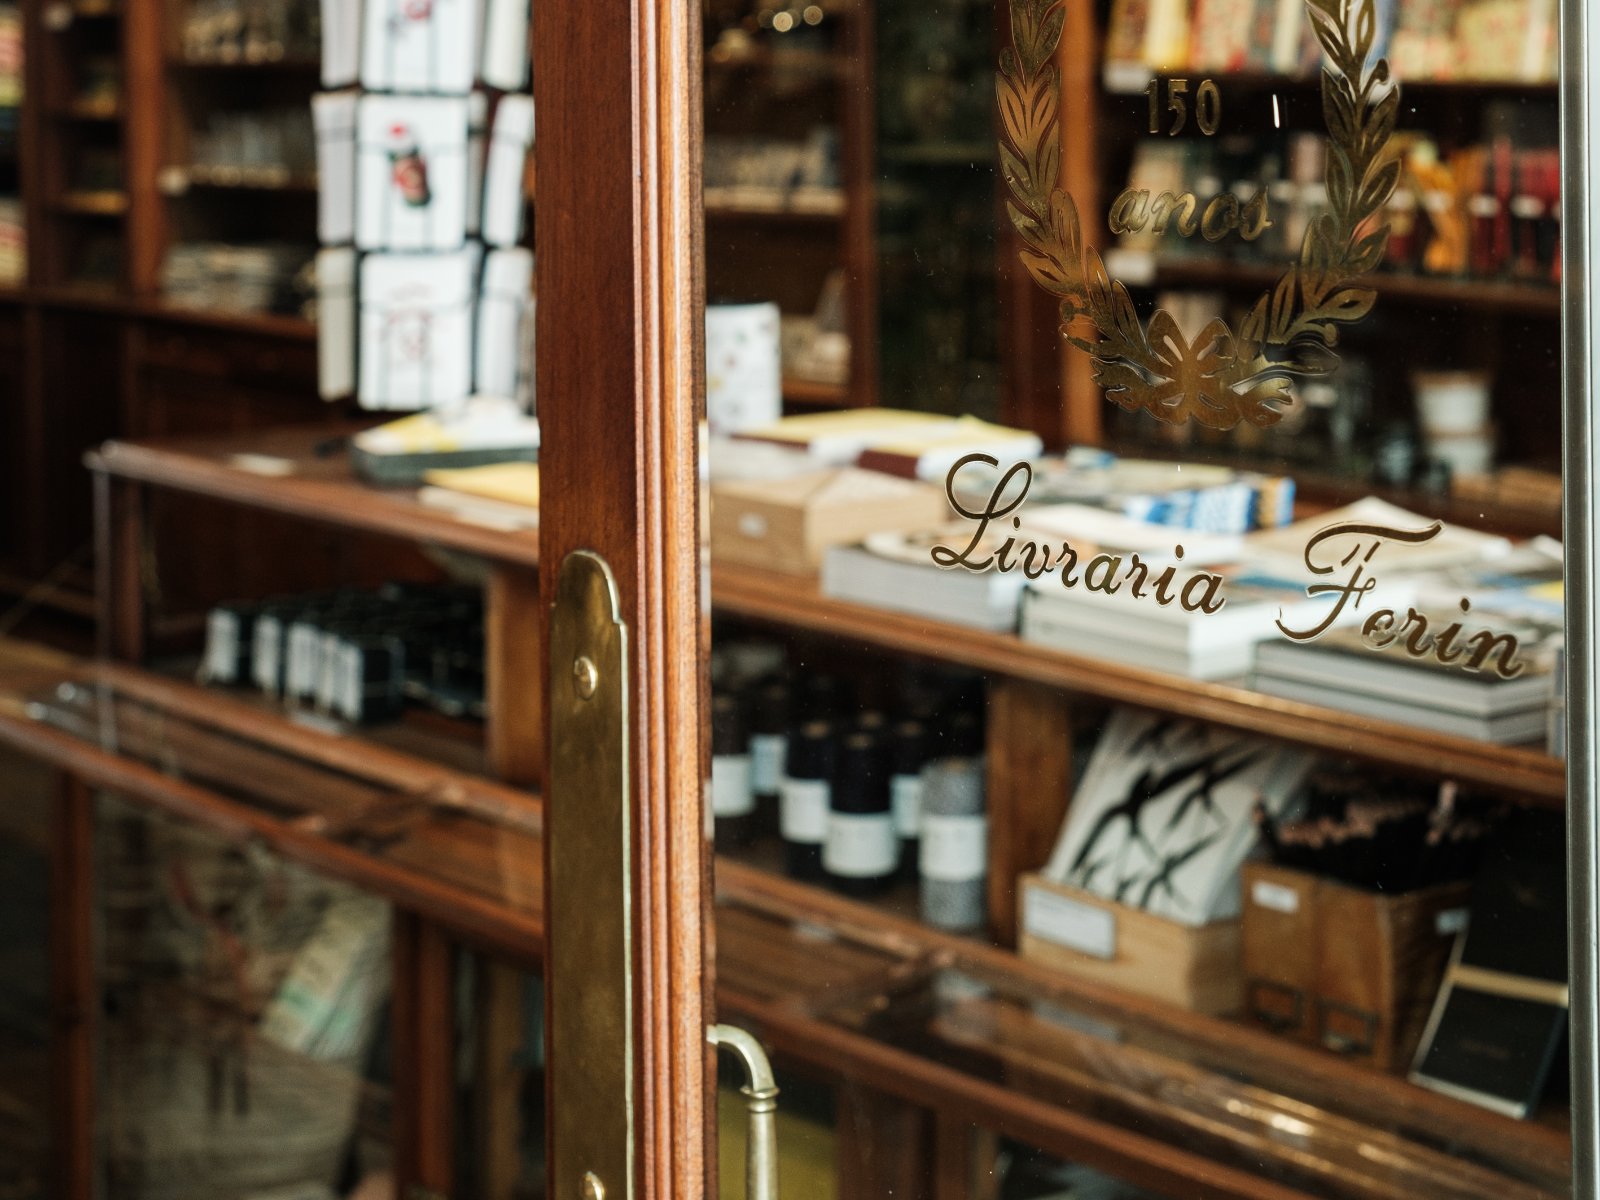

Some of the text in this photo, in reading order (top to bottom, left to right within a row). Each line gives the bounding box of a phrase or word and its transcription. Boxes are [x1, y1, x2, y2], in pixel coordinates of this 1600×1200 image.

[1144, 78, 1222, 136] 150
[1108, 186, 1275, 242] anos
[930, 452, 1527, 680] Livraria Ferin
